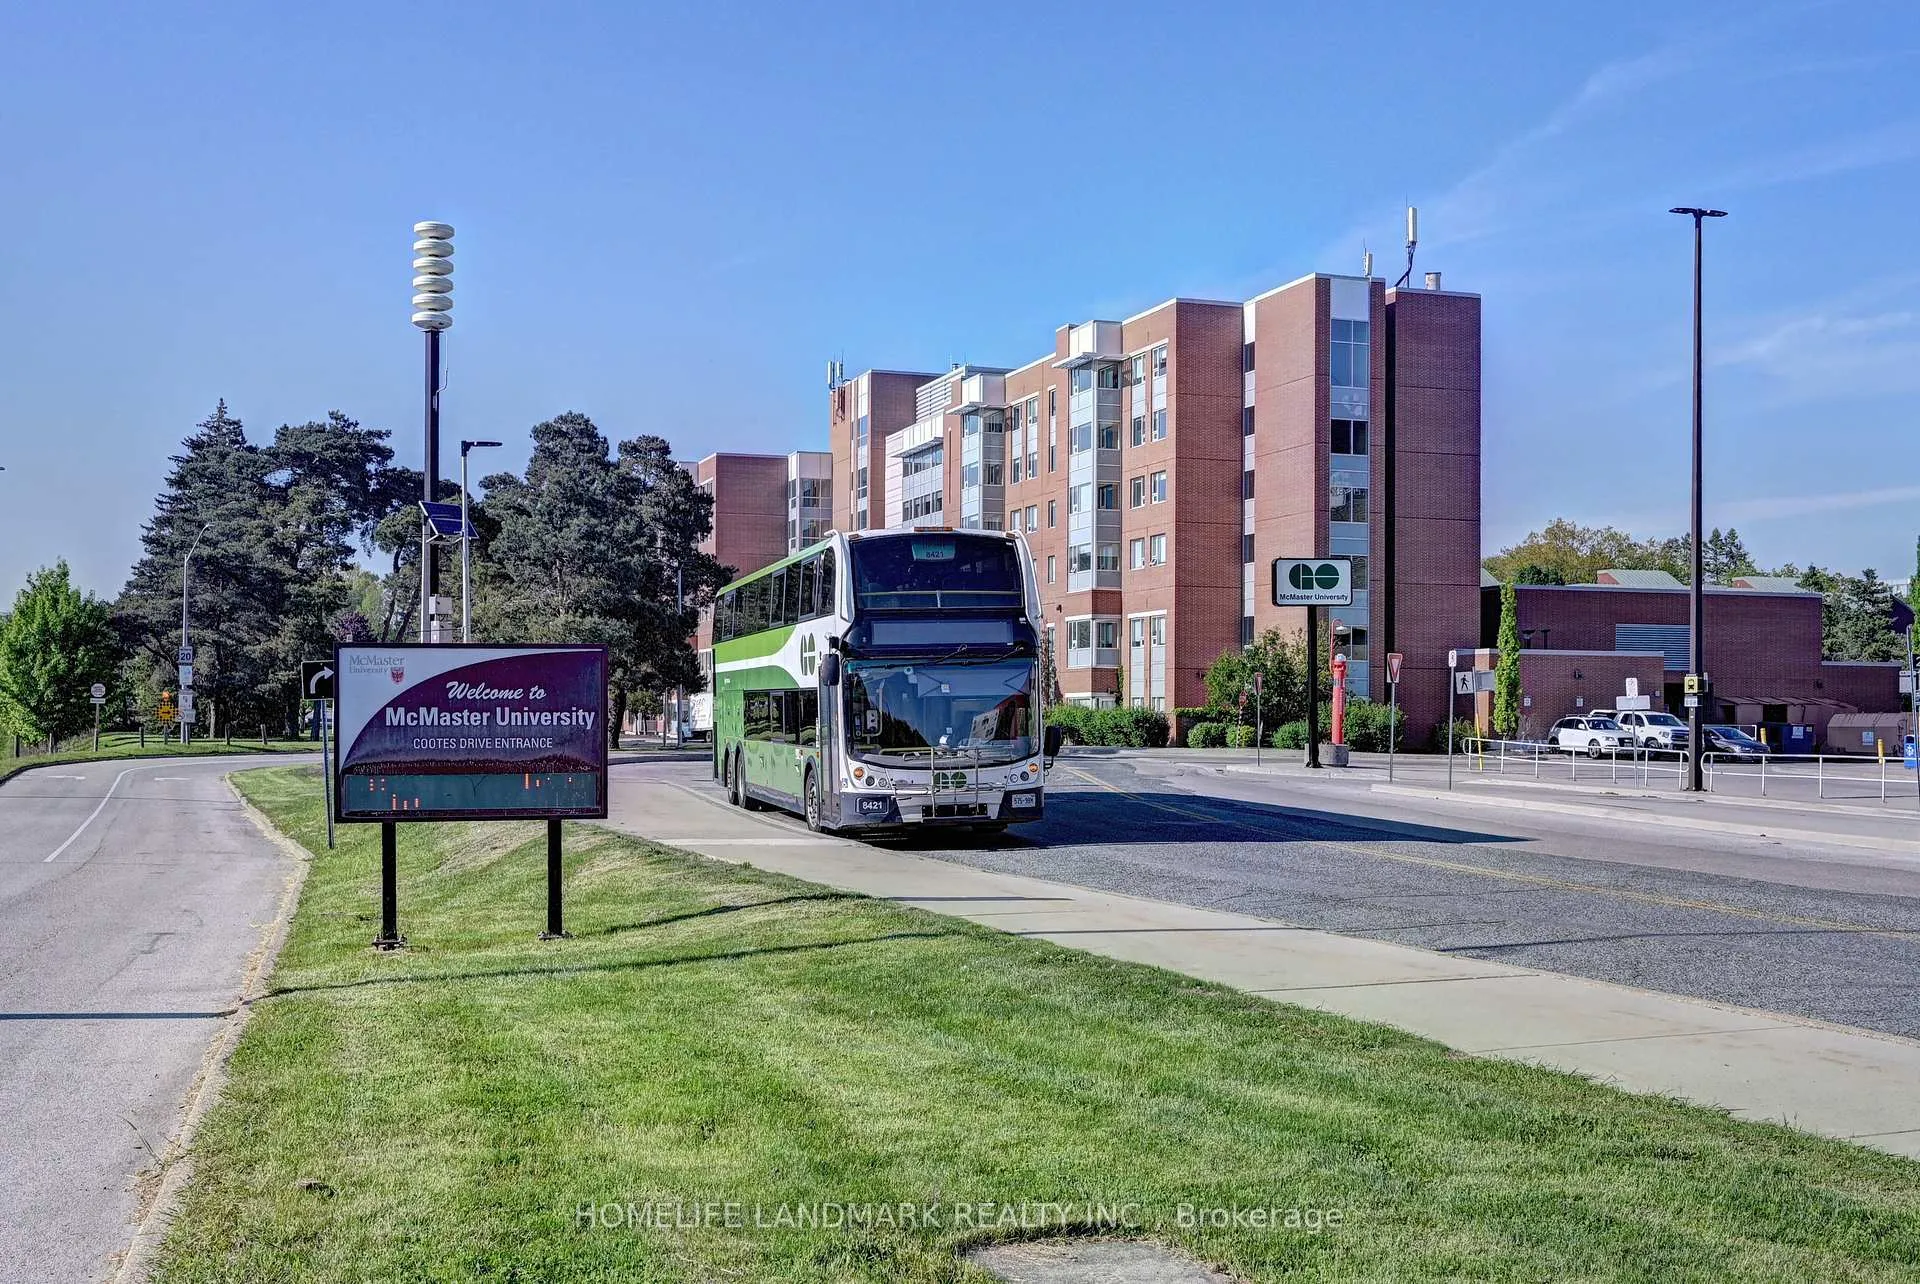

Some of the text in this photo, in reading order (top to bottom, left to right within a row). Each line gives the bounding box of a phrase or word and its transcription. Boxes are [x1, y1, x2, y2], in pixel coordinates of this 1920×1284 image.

[1279, 593, 1348, 601] McMaster University
[180, 652, 192, 661] 20
[349, 655, 405, 666] McMaster
[349, 666, 389, 674] University
[446, 681, 547, 700] Welcome to
[385, 706, 596, 730] McMaster University
[413, 738, 553, 749] COOTES DRIVE ENTRANCE
[862, 801, 883, 810] 8421
